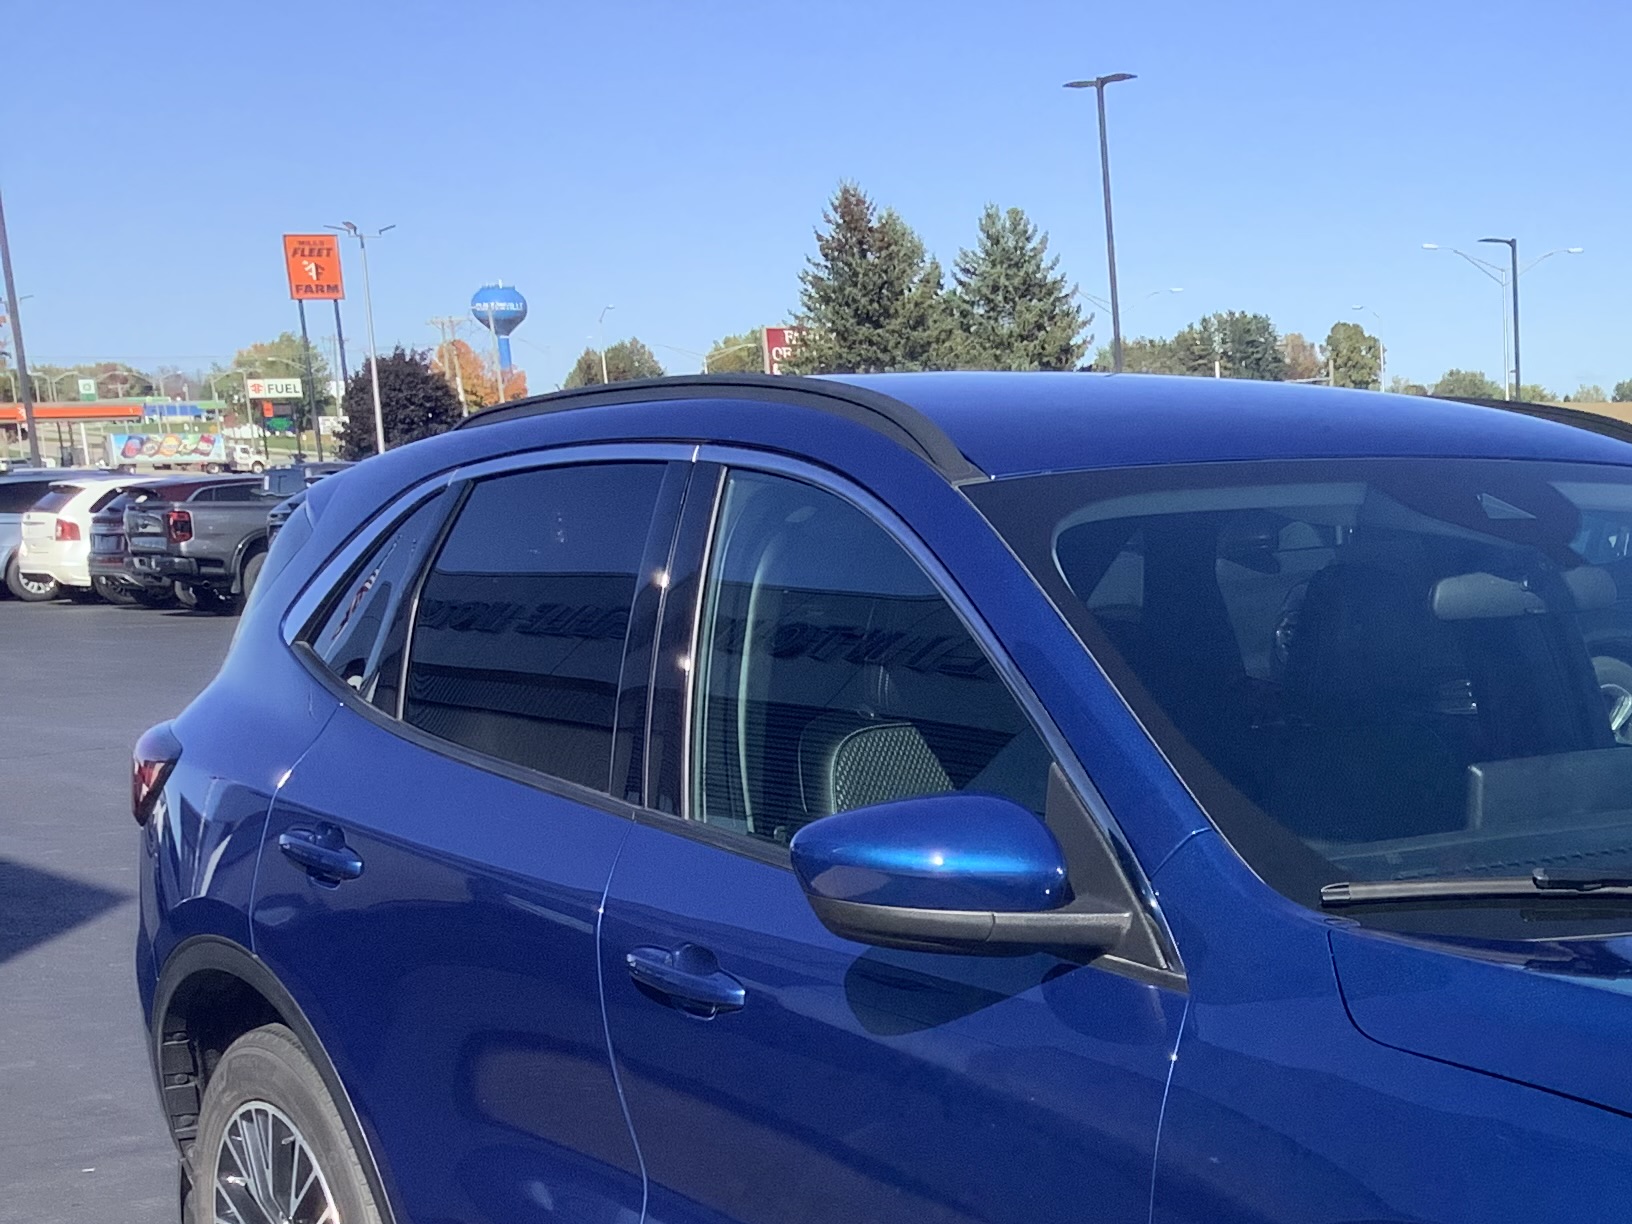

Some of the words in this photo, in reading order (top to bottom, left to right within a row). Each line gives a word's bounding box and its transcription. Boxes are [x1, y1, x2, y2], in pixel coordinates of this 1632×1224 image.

[291, 247, 333, 258] FLEET
[295, 284, 340, 294] FARM
[267, 383, 300, 394] FUEL
